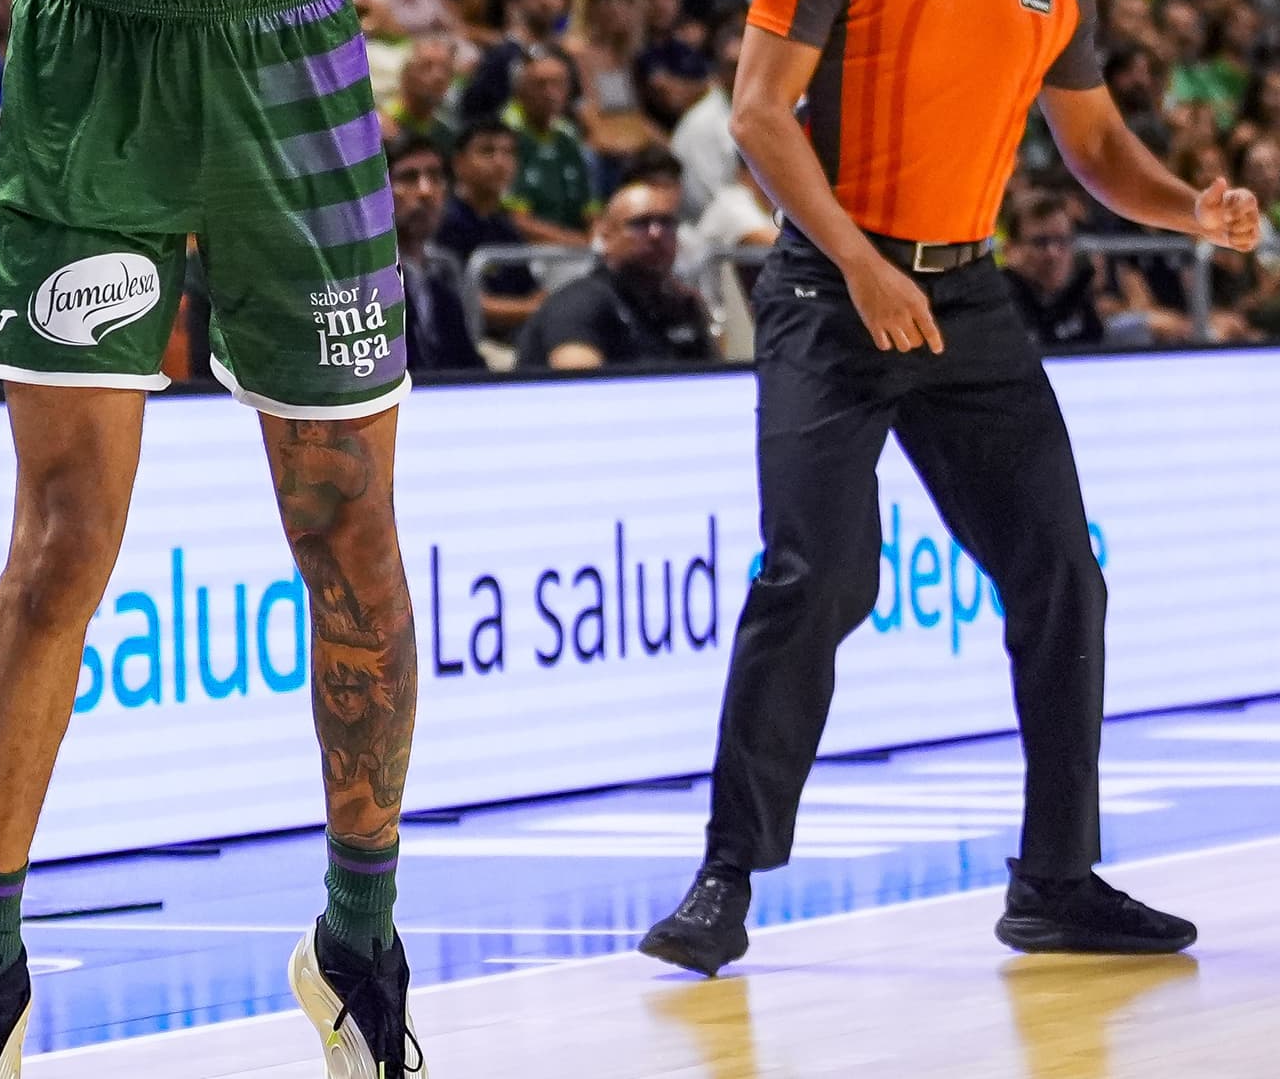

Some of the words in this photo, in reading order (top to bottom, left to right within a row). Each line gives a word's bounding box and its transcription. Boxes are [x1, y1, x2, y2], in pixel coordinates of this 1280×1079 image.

[42, 260, 155, 327] famadesa
[310, 284, 360, 307] sabor
[313, 311, 325, 325] a
[324, 288, 387, 337] má
[317, 333, 391, 377] laga
[430, 543, 505, 679] La
[534, 514, 719, 665] salud
